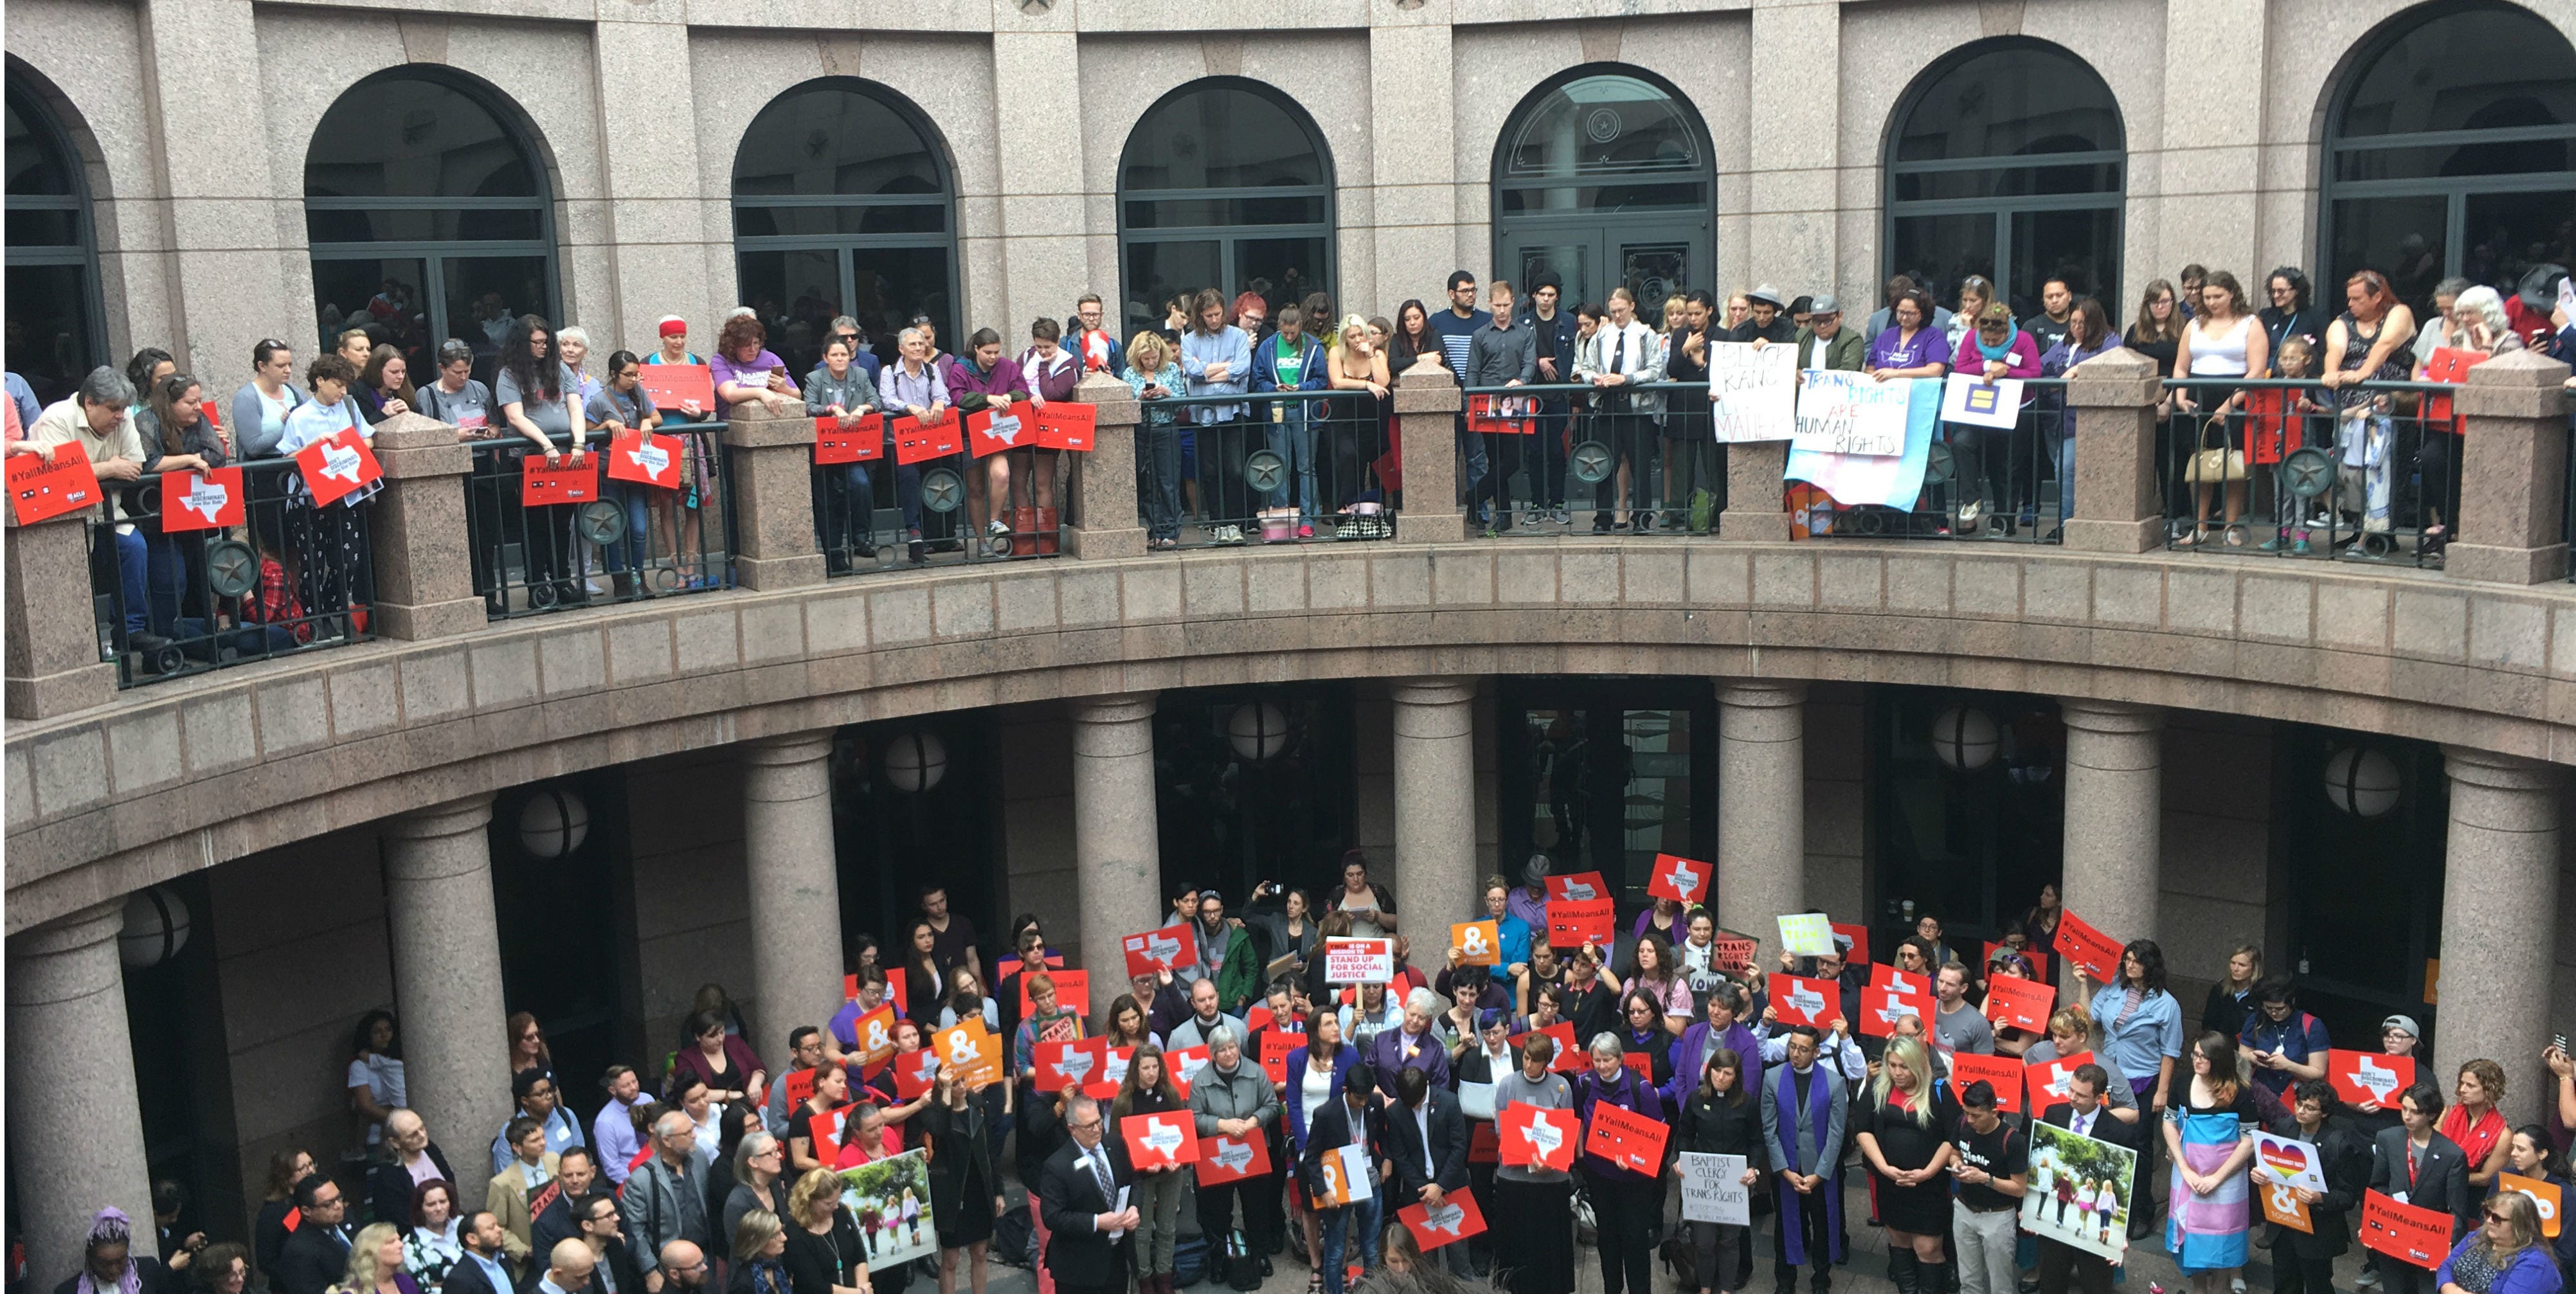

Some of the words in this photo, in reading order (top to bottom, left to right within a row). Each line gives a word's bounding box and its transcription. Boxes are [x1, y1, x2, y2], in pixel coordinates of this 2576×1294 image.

[1803, 370, 1855, 389] TRANS
[1848, 386, 1905, 405] RIGHTS
[1036, 411, 1092, 422] #YallMeansAll
[1828, 404, 1859, 418] ARE
[820, 424, 878, 436] #YallMeansAll
[899, 418, 955, 436] #YallMeansAll
[1795, 416, 1854, 436] HUMAN
[1835, 435, 1895, 454] RIGHTS
[10, 456, 84, 483] #YallMeansAll
[1551, 908, 1610, 919] #YallMeansAll
[1717, 942, 1751, 953] TRANS
[2064, 921, 2116, 958] #YallMeansAll
[1992, 985, 2048, 1003] #YallMeansAll
[1041, 1019, 1070, 1042] TRANS
[1957, 1065, 2017, 1079] #YallMeansAll
[1598, 1113, 1662, 1143] #YallMeansAll
[1959, 1140, 1971, 1151] mi
[1691, 1155, 1730, 1167] BAPTIST
[1695, 1167, 1727, 1179] CLERGY
[1705, 1179, 1721, 1190] FOR
[1685, 1188, 1712, 1200] TRANS
[1713, 1190, 1743, 1203] RIGHTS
[2271, 1211, 2305, 1227] TOGETHER
[2370, 1203, 2446, 1235] #YallMeansAll
